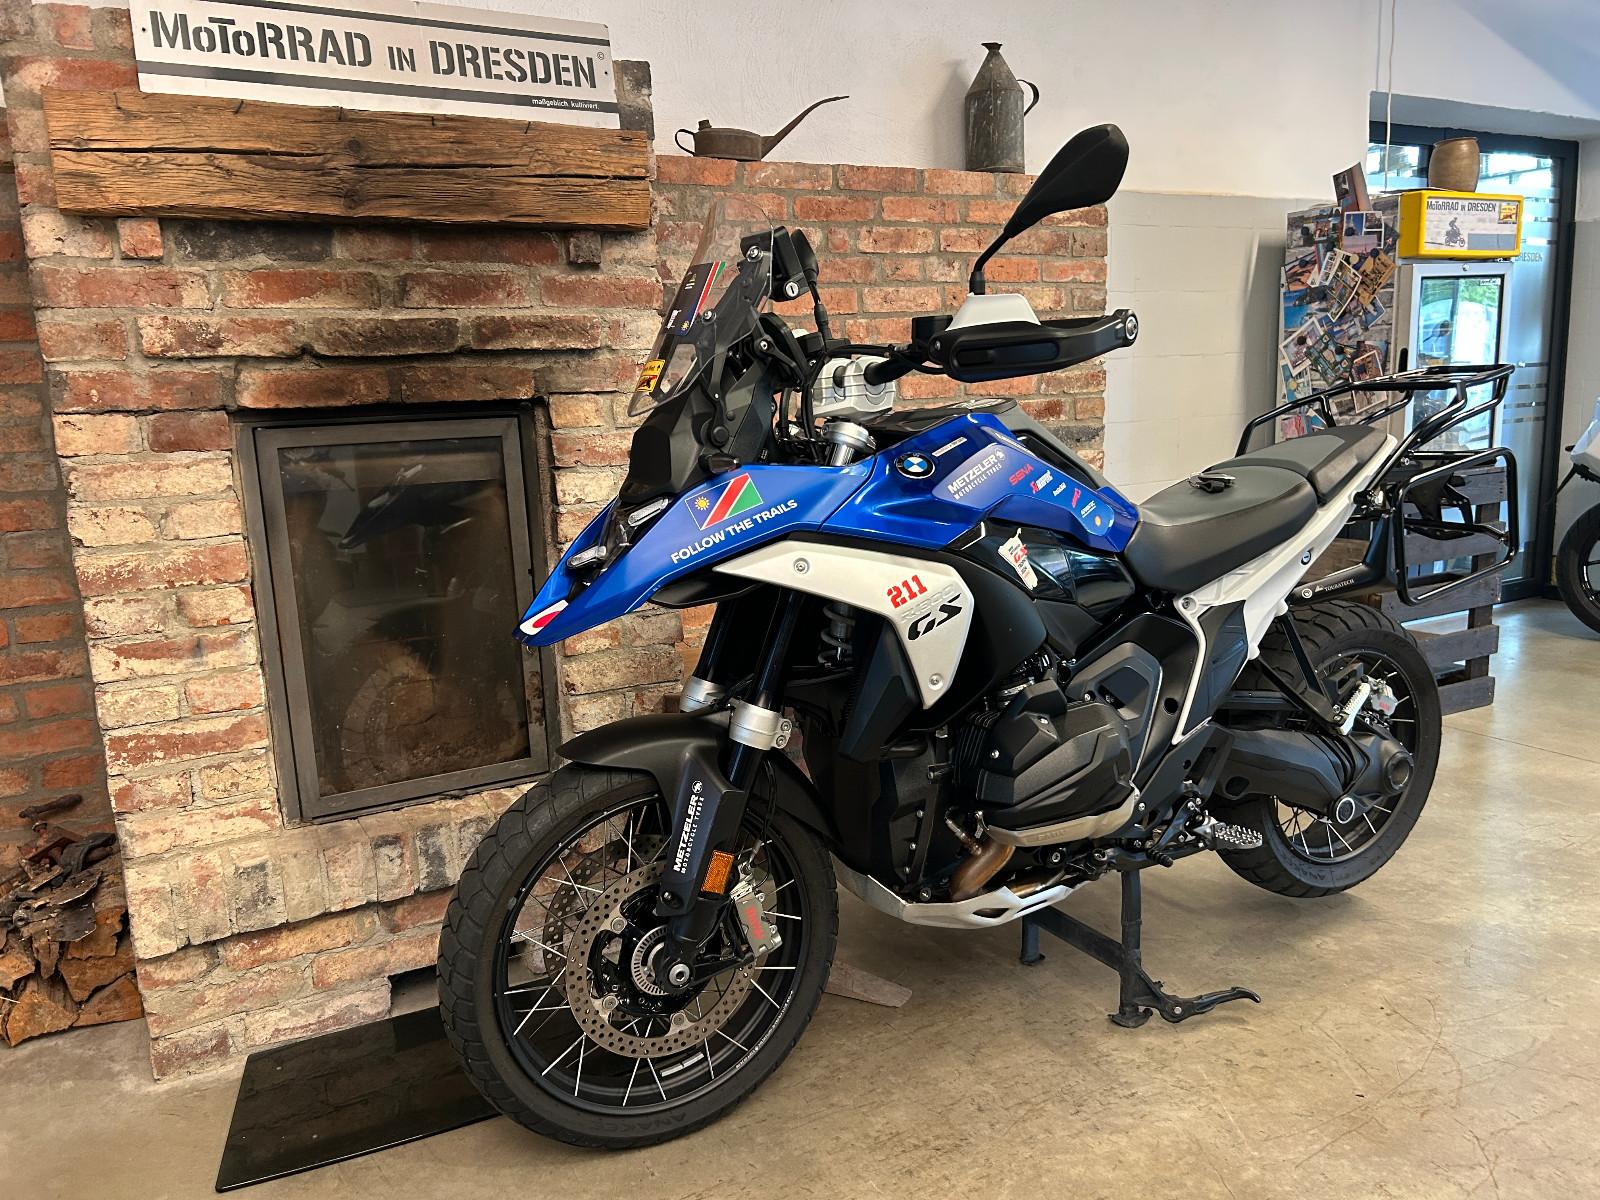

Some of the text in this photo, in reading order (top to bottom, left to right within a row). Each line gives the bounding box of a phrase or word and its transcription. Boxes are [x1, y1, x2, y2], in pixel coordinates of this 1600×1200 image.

[428, 40, 597, 89] DRESDEN
[1467, 202, 1497, 213] DRESDEN
[947, 453, 998, 494] METZELER
[953, 474, 987, 501] MOTORCYCLE
[670, 499, 798, 564] FOLLOW THE TRAILS
[886, 574, 928, 609] 211
[907, 592, 963, 641] GS
[672, 794, 699, 872] METZELER
[680, 823, 698, 875] MOTORCYCLE
